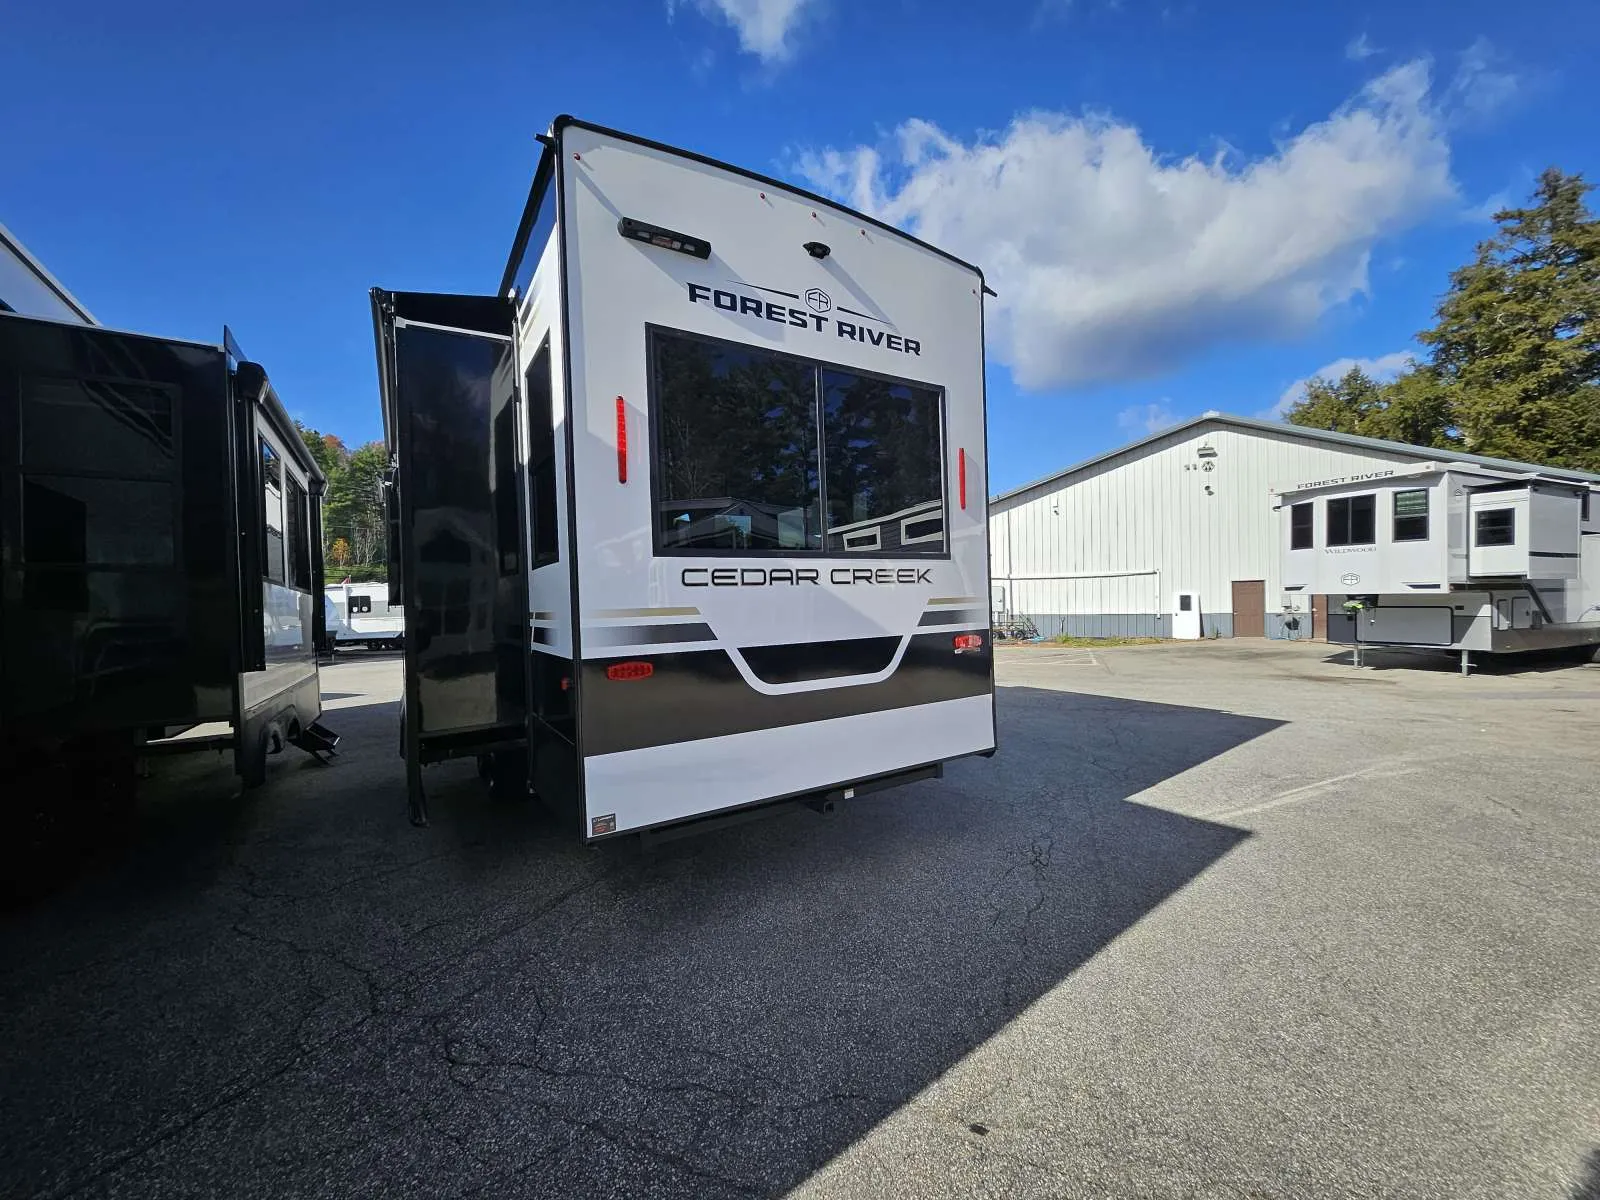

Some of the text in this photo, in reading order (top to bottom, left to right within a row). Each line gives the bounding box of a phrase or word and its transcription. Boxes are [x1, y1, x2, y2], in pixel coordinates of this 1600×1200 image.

[686, 282, 921, 356] FOREST RIVER
[1297, 470, 1394, 489] FOREST RIVER
[681, 568, 933, 587] CEDAR CREEK
